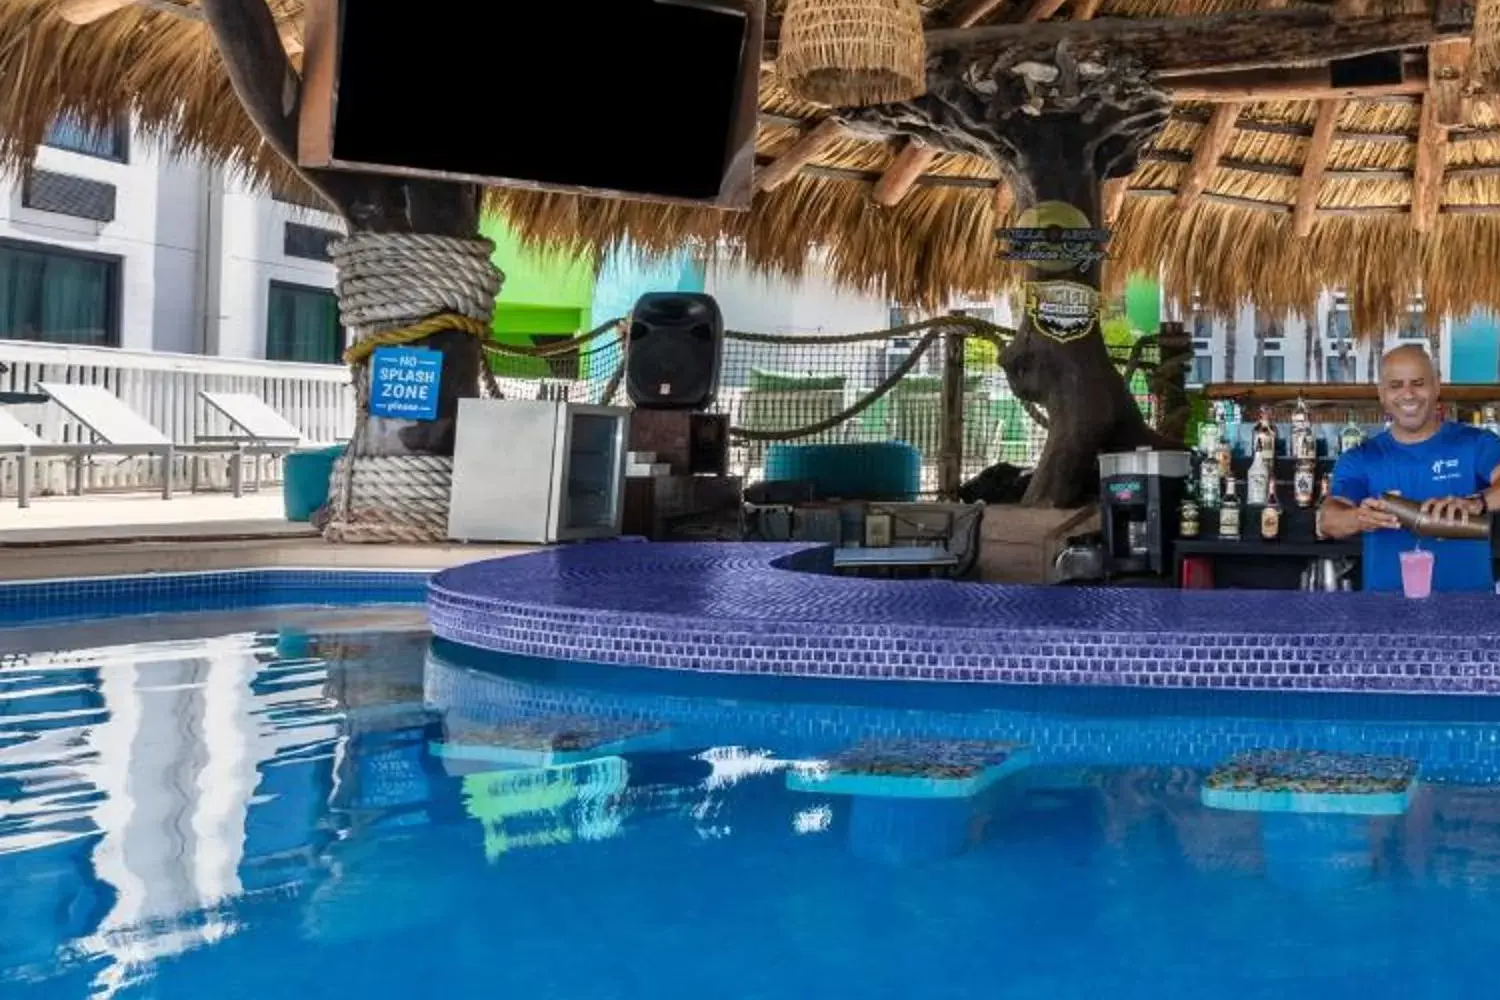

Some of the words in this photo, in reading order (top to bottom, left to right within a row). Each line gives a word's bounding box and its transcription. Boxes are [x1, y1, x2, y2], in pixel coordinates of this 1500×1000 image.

[399, 355, 418, 368] NO
[379, 367, 435, 383] SPLASH
[381, 383, 429, 400] ZONE
[387, 401, 419, 413] please
